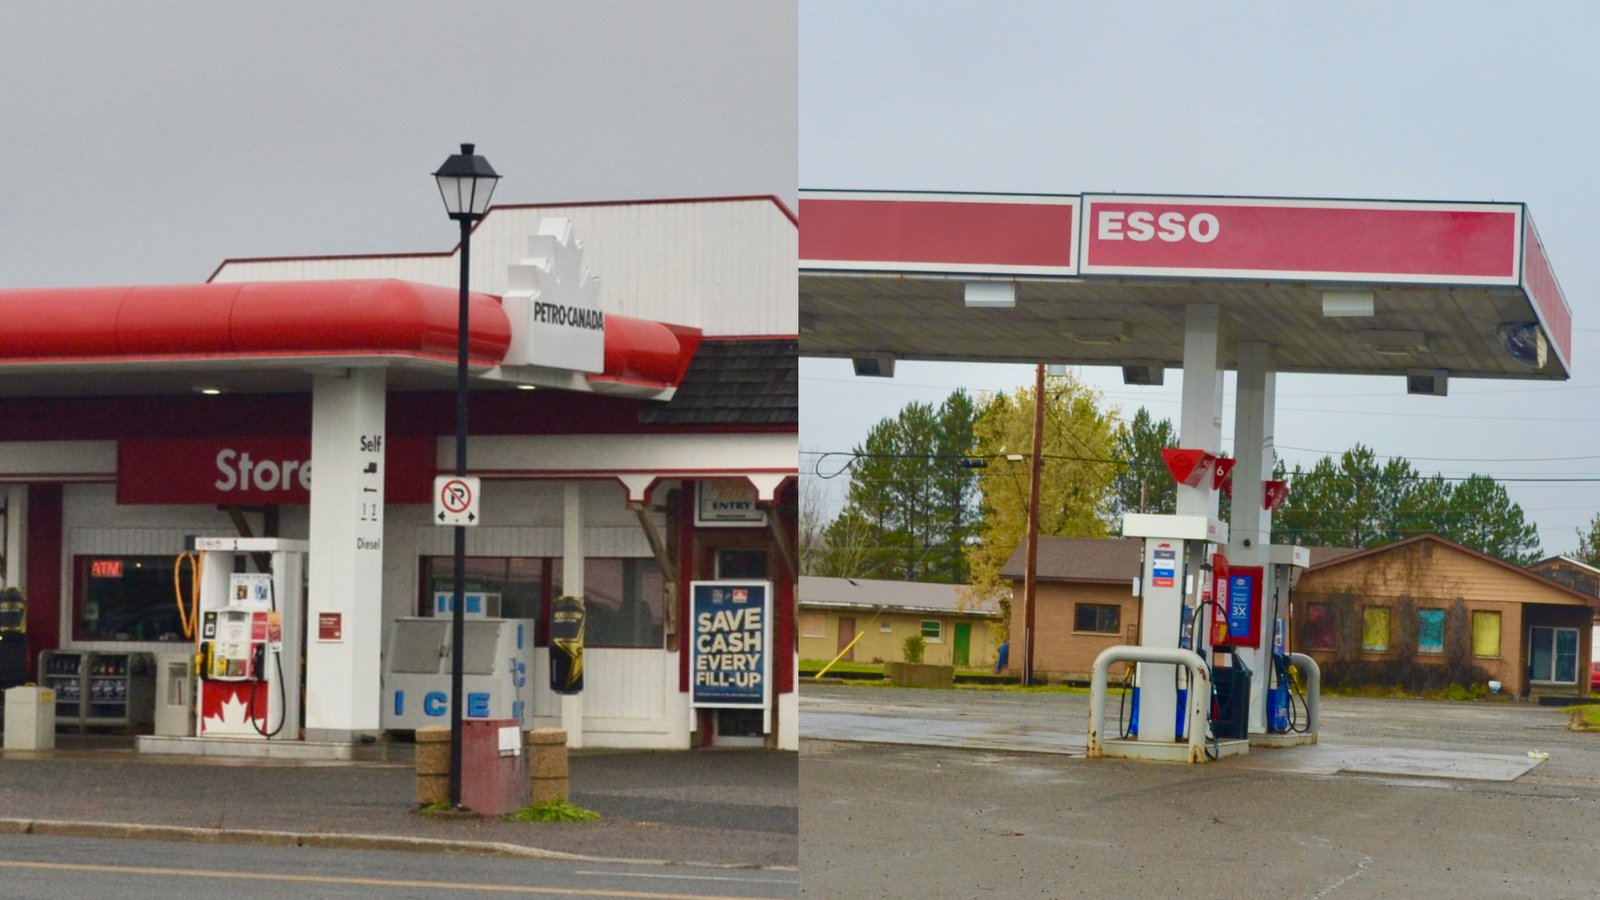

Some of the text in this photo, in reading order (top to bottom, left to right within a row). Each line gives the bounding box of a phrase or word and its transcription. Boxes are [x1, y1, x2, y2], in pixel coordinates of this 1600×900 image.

[1098, 211, 1220, 243] ESSO
[360, 435, 382, 452] Self
[1216, 465, 1225, 476] 6
[1267, 487, 1275, 497] 4
[712, 501, 751, 510] ENTRY
[357, 537, 380, 550] Diesel
[92, 561, 120, 576] ATM
[1232, 606, 1246, 616] 3X
[698, 607, 762, 633] SAVE
[697, 631, 762, 653] CASH
[696, 653, 761, 670] EVERY
[696, 671, 762, 688] FILL-UP
[394, 690, 490, 718] ICE
